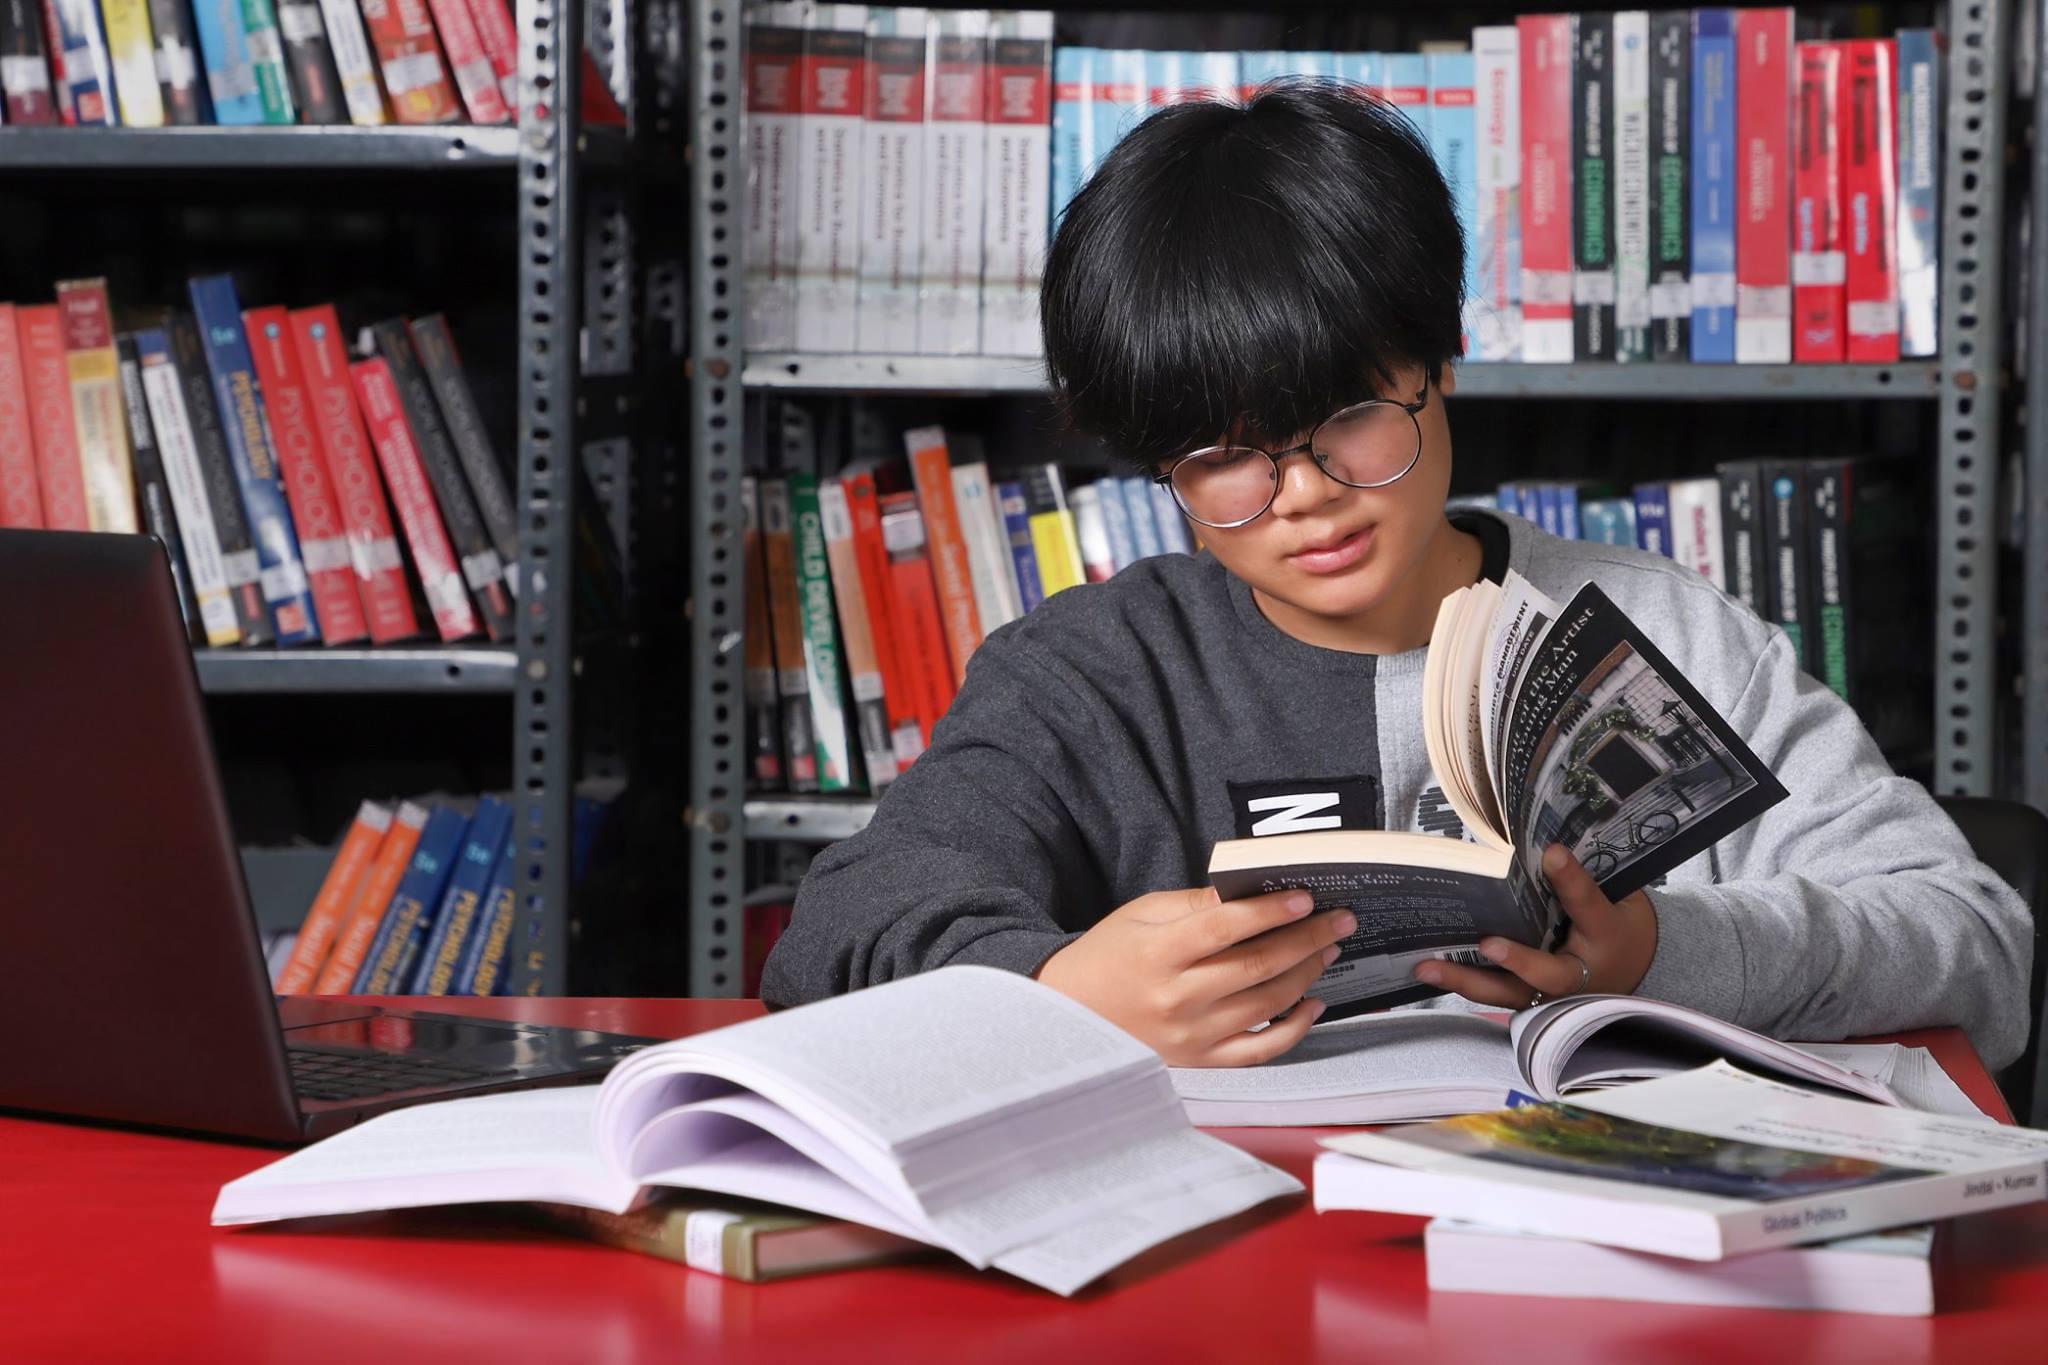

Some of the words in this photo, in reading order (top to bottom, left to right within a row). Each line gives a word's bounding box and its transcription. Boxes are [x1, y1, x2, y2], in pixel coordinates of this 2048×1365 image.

[1582, 159, 1604, 262] ECONOMICS
[1659, 155, 1681, 259] ECONOMICS
[230, 369, 273, 479] PSYCHOLOGY
[277, 385, 335, 540] PSYCHOLOG
[322, 385, 384, 536] PSYCHOLOG
[799, 512, 825, 577] CHILD
[807, 578, 839, 701] DEVELOP
[1497, 599, 1529, 679] MANAGEMENT
[1520, 630, 1535, 657] DATE
[1529, 664, 1551, 698] the
[1552, 606, 1596, 662] Artist
[1544, 649, 1579, 691] Man
[1821, 606, 1846, 700] ECONOMI
[300, 912, 335, 967] Social
[341, 913, 379, 968] Social
[367, 898, 420, 995] PSYCHOLOG
[1761, 1214, 1800, 1234] Global
[1804, 1206, 1847, 1226] Politics
[2003, 1175, 2038, 1190] Kumar
